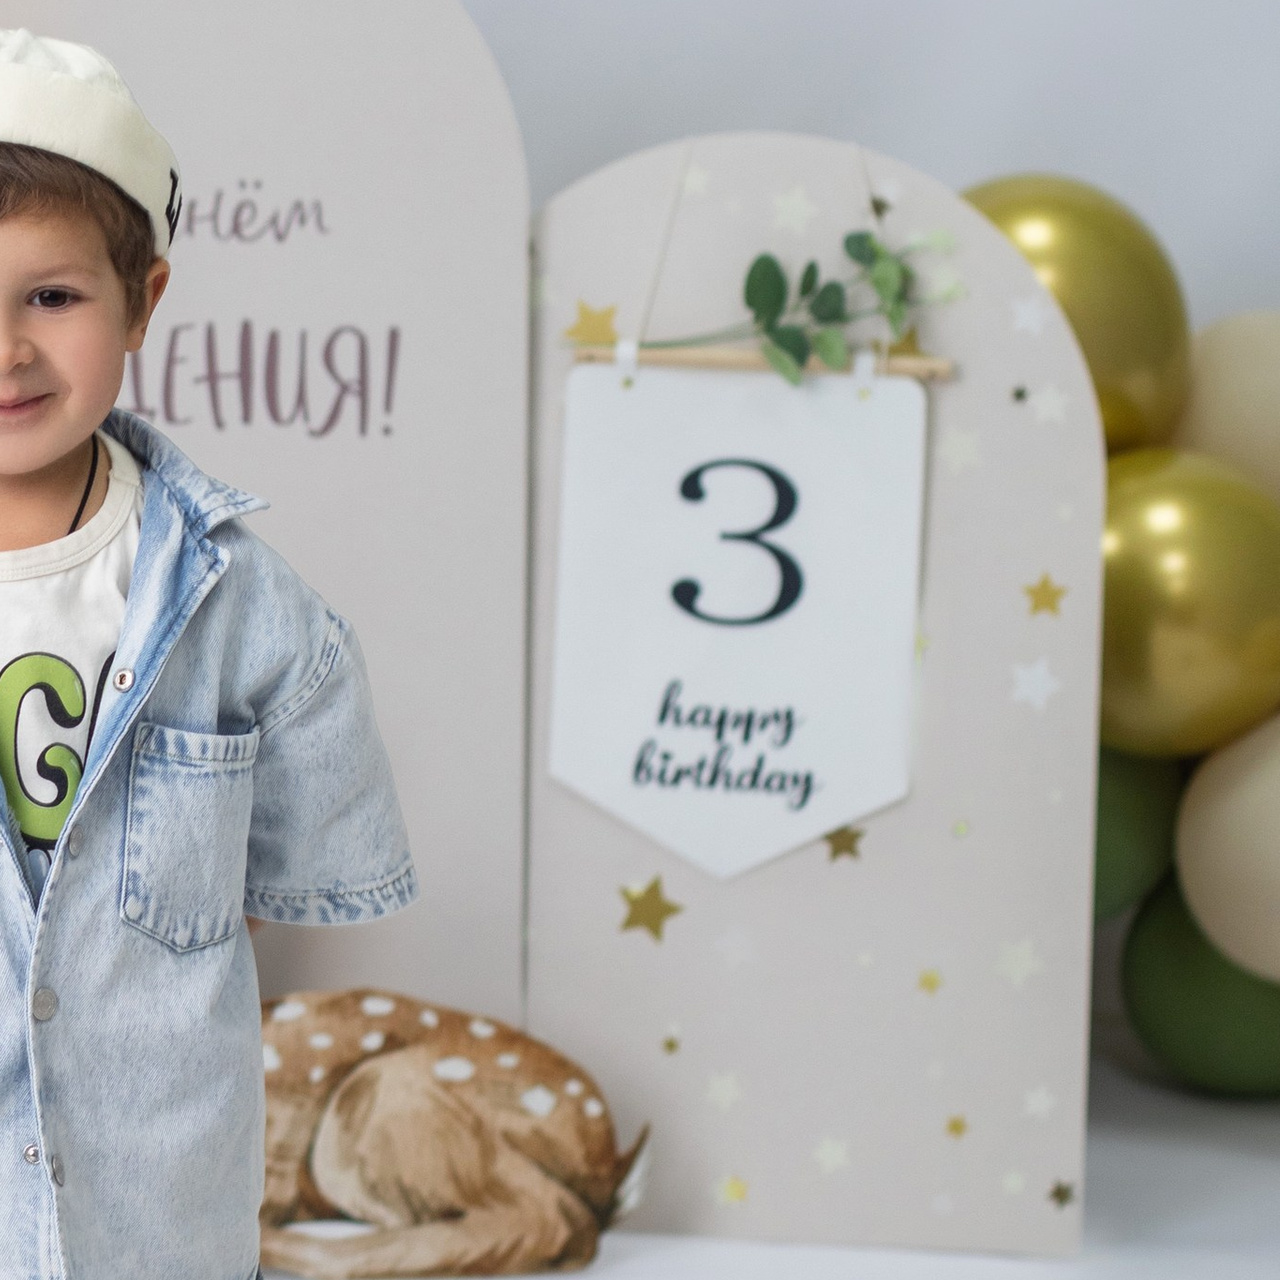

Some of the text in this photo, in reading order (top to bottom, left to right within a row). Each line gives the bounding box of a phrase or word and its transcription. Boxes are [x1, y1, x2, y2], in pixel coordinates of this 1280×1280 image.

[175, 179, 330, 243] нём
[671, 458, 805, 627] 3
[658, 679, 800, 747] happy
[632, 739, 818, 812] birthday
